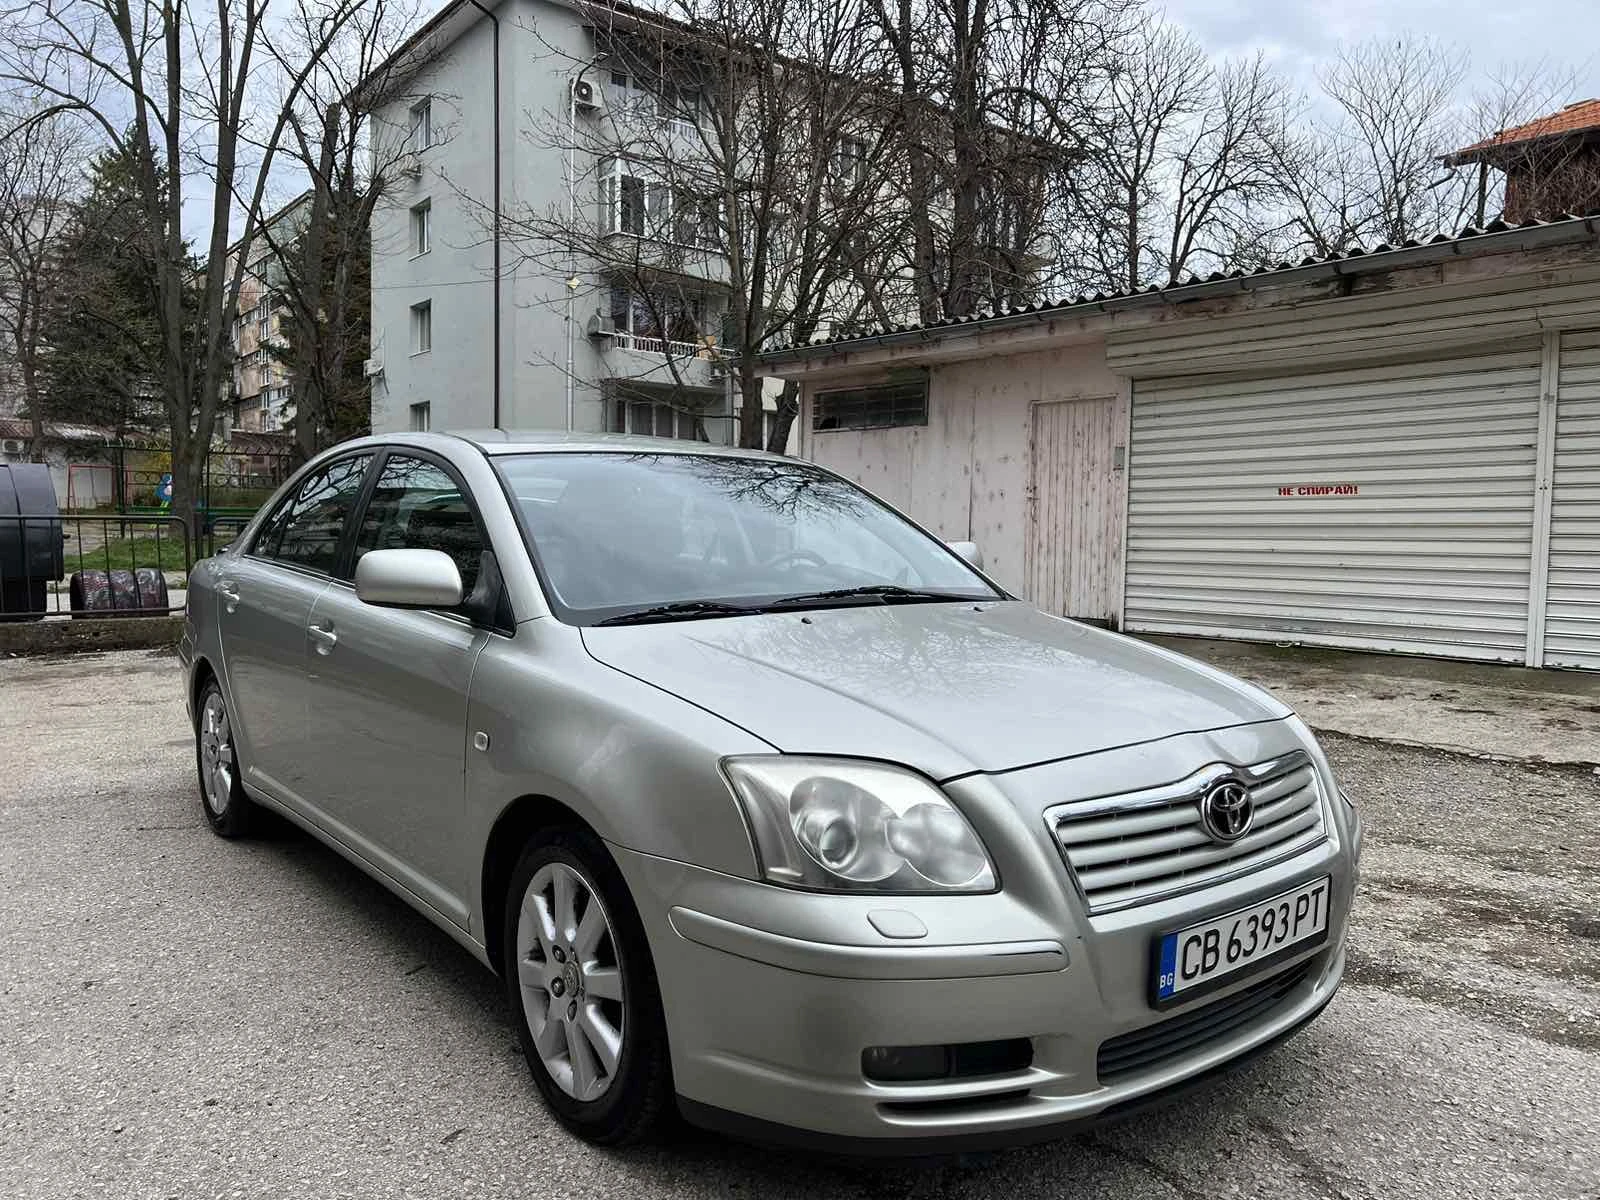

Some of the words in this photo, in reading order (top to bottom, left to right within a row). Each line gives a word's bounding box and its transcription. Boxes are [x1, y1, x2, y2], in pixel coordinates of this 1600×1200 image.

[1278, 487, 1294, 496] НЕ
[1298, 484, 1358, 495] СПИРАЙ!
[1160, 973, 1174, 988] BG
